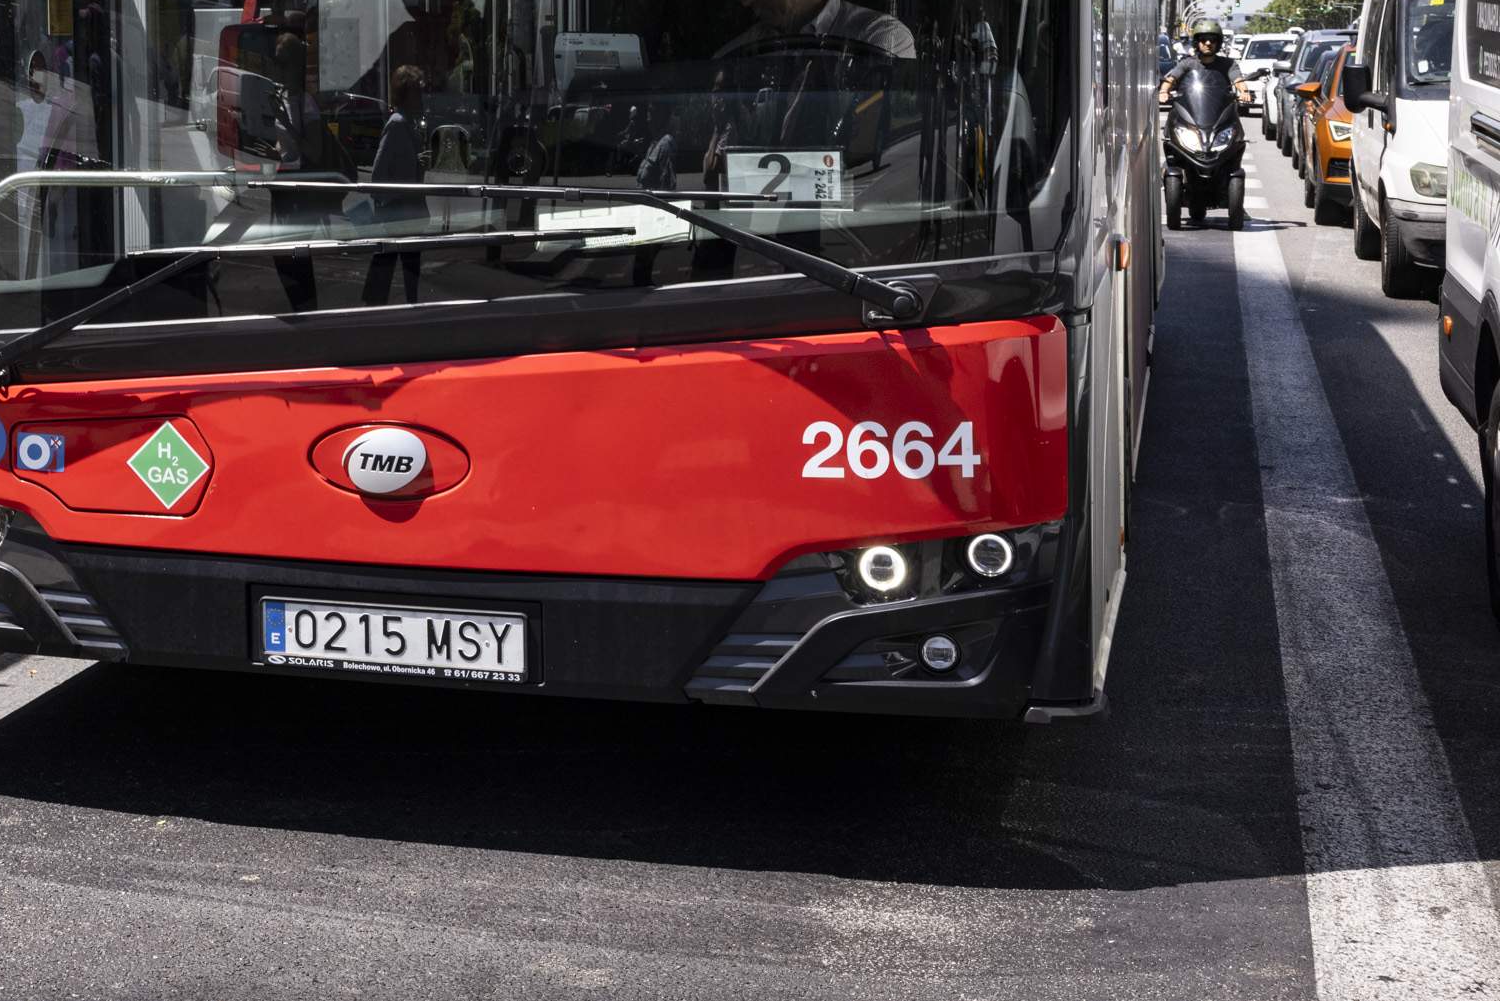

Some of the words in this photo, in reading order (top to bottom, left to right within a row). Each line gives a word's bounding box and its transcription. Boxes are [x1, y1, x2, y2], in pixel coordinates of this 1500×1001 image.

[758, 154, 792, 200] 2
[802, 420, 981, 479] 2664
[147, 466, 189, 485] GAS
[360, 453, 414, 473] TMB
[271, 632, 280, 644] E
[294, 609, 406, 657] 0215
[427, 617, 511, 664] MSY
[288, 657, 334, 668] SOLARIS
[343, 661, 383, 673] Bolechowo,
[383, 664, 391, 672] ul.
[392, 665, 426, 675] Obornicka
[427, 668, 436, 676] 46
[471, 670, 490, 680] 667
[492, 672, 505, 681] 23
[508, 673, 521, 682] 33
